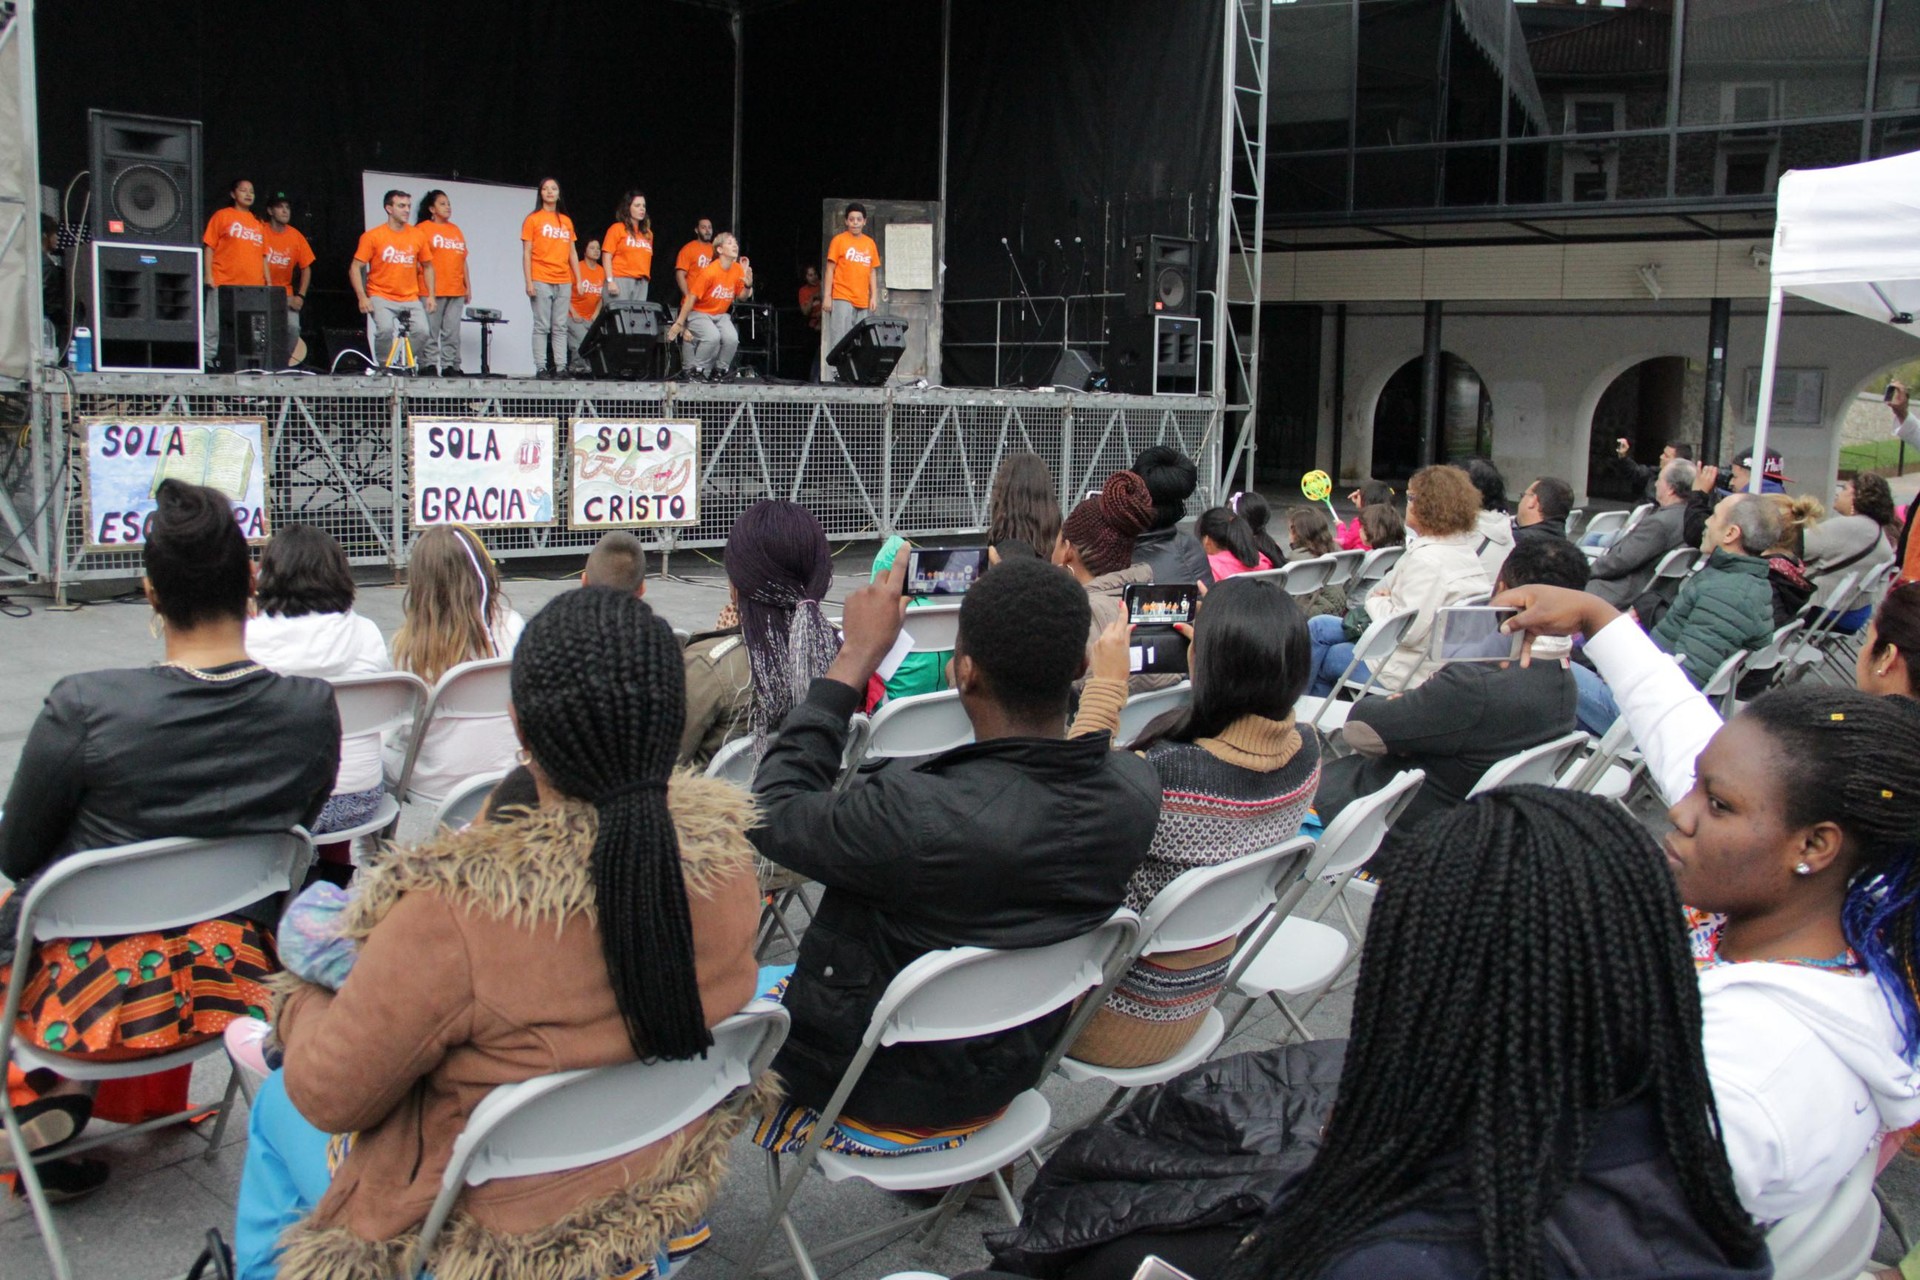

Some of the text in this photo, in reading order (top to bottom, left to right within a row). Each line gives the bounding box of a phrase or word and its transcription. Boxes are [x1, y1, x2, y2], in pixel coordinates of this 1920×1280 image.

[101, 425, 185, 457] SOLA
[428, 426, 501, 461] SOLA
[596, 426, 672, 452] SOLO
[421, 486, 527, 522] GRACIA
[583, 490, 686, 522] CRISTO
